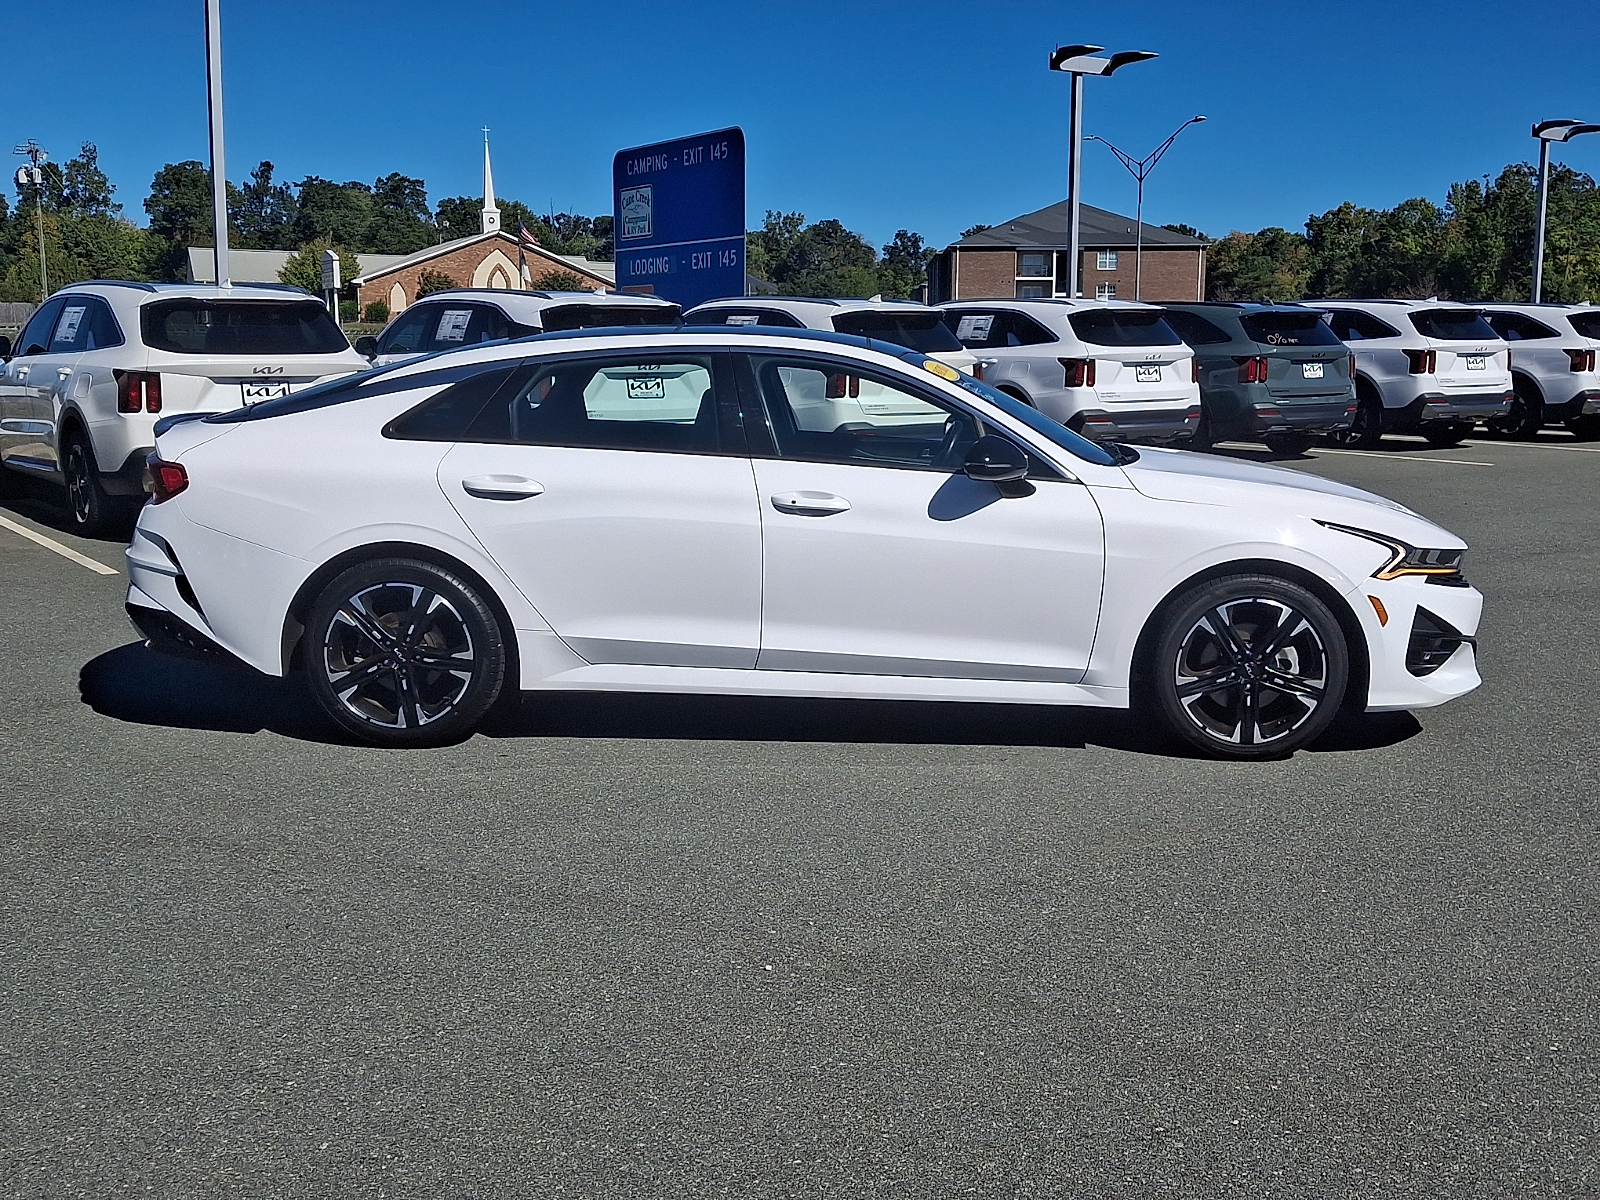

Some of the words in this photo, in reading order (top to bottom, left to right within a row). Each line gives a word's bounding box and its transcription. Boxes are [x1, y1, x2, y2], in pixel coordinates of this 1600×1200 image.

[627, 154, 668, 175] CAMPING
[683, 147, 703, 166] EXIT
[710, 142, 728, 161] 145
[635, 190, 650, 207] Creek
[630, 257, 669, 275] LODGING
[691, 252, 712, 270] EXIT
[718, 250, 737, 268] 145
[1138, 368, 1158, 376] KIA
[246, 387, 286, 397] KIA
[630, 382, 661, 391] KIA
